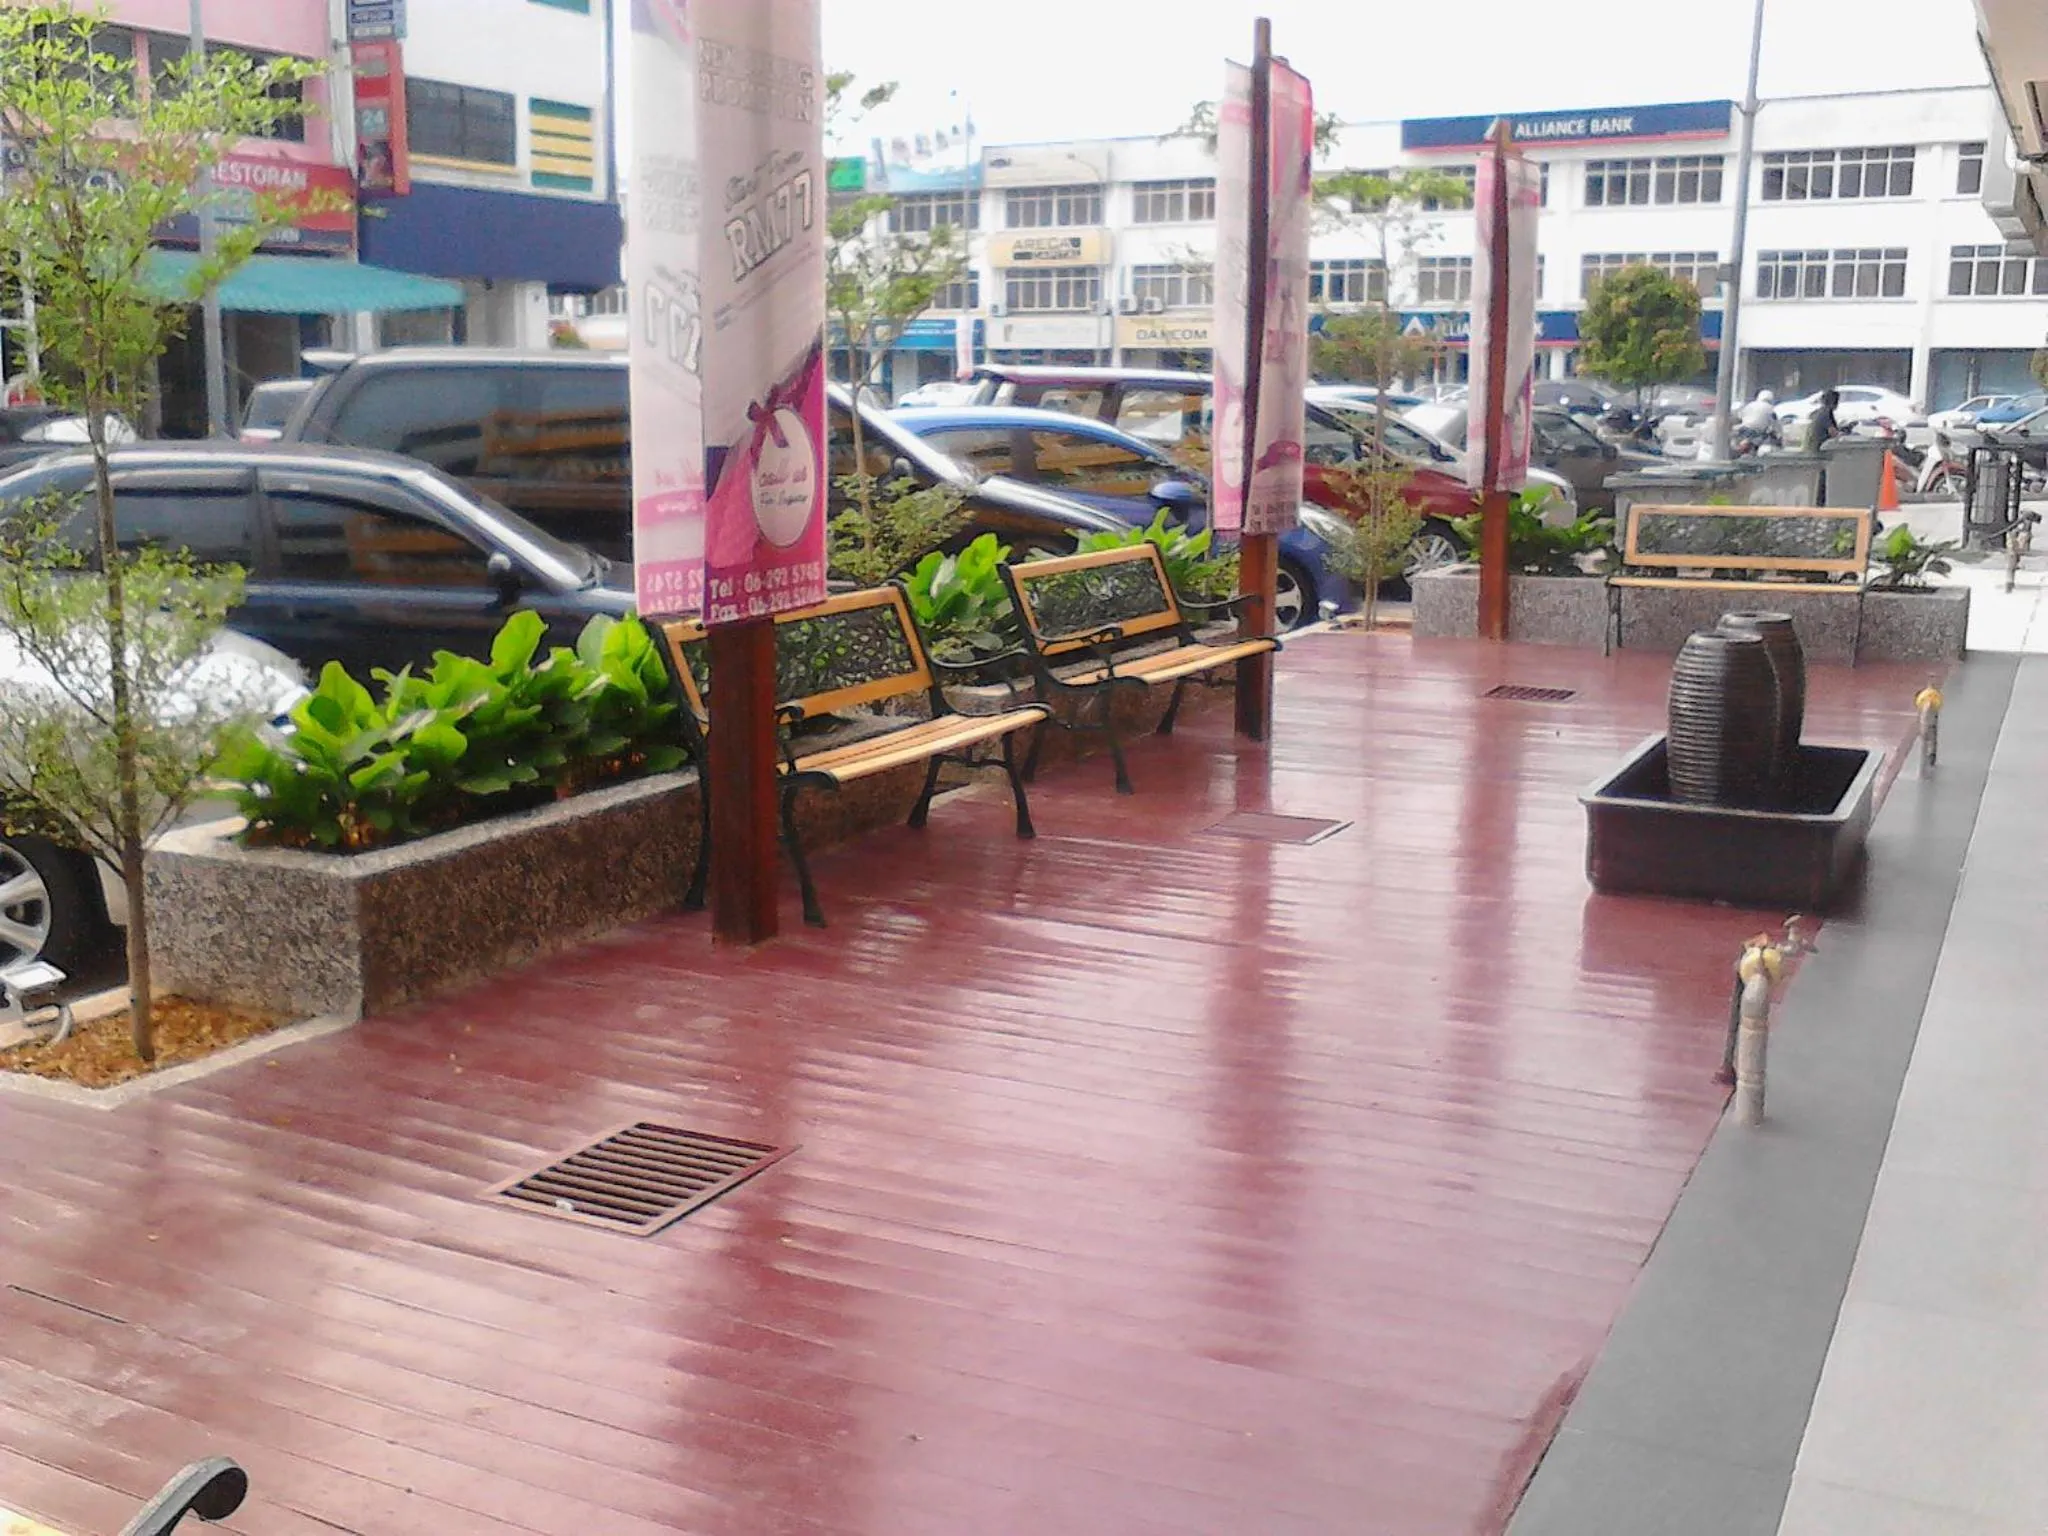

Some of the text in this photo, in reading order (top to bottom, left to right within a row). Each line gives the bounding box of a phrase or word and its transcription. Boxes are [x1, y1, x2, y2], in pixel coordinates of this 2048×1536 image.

[1515, 116, 1634, 138] ALLIANCE BANK
[211, 160, 308, 189] ESTORAN
[724, 167, 813, 283] RM77
[710, 577, 734, 600] Tel
